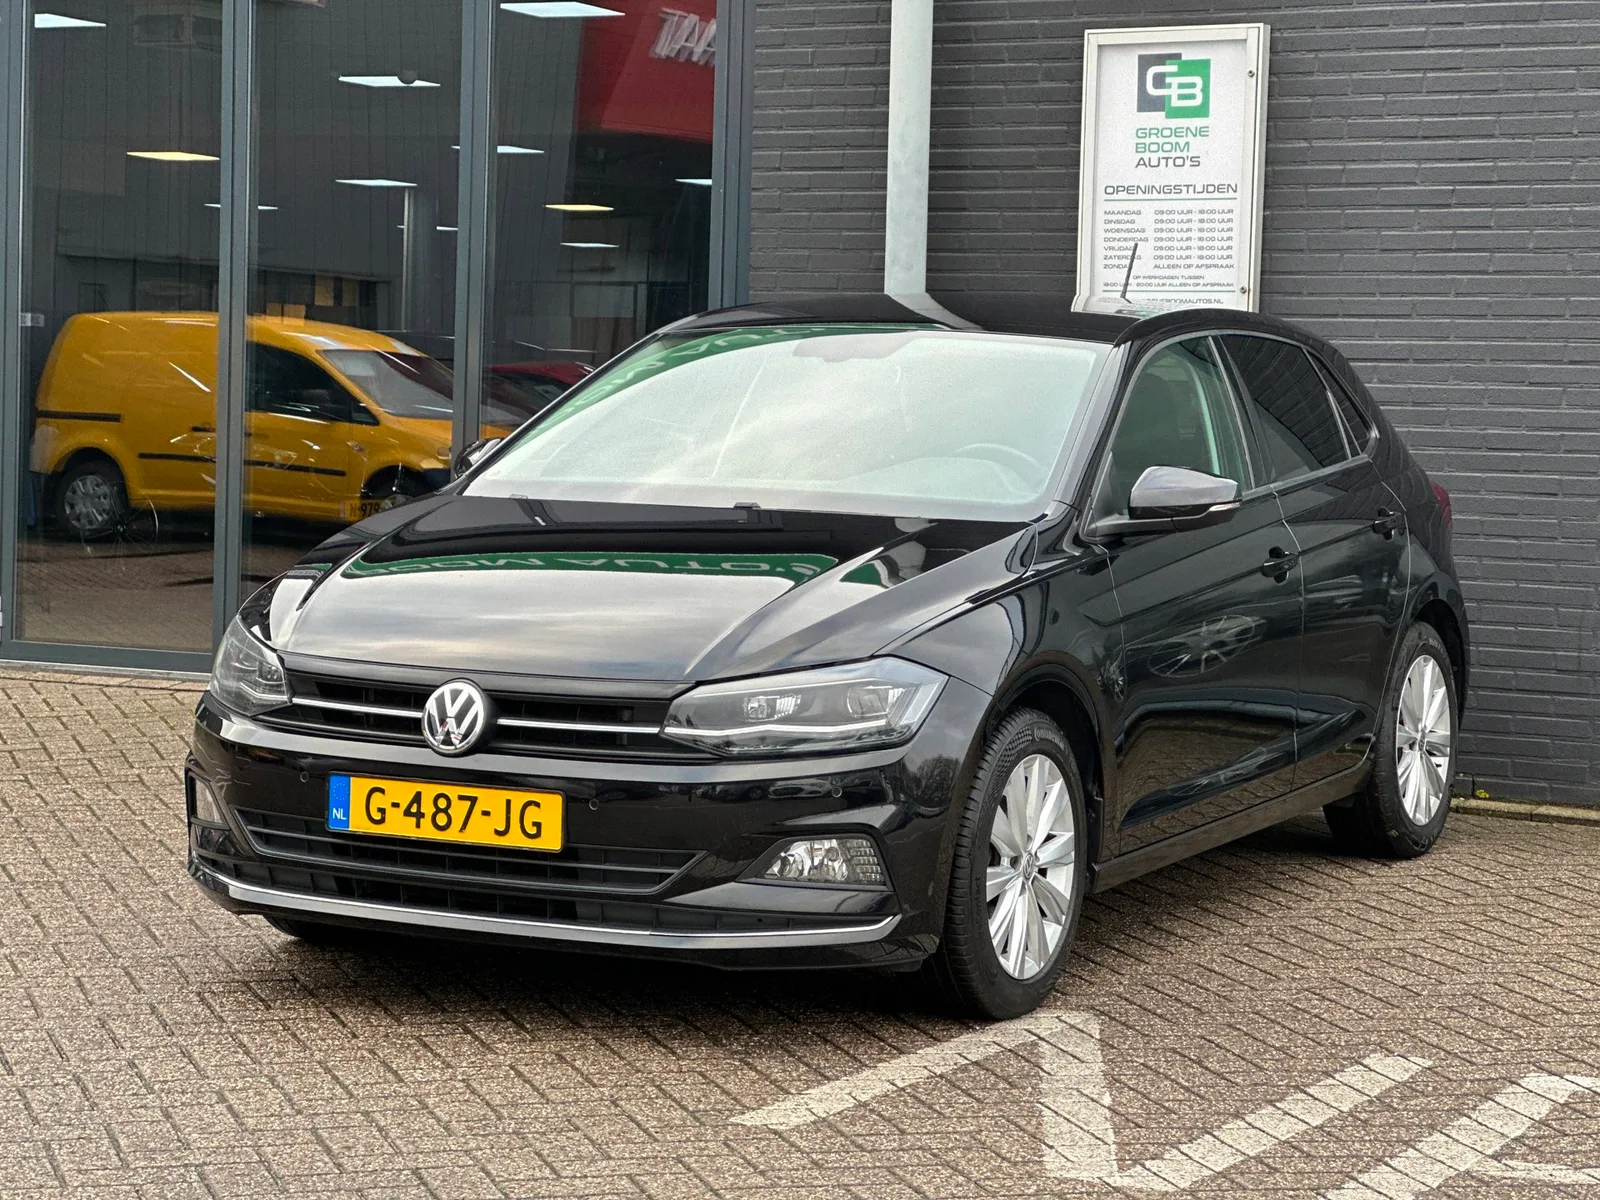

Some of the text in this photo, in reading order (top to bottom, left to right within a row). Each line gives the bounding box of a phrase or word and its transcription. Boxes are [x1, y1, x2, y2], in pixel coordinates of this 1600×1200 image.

[1135, 126, 1210, 139] GROENE
[1135, 141, 1190, 154] BOOM
[1135, 156, 1201, 168] AUTO'S
[1104, 183, 1238, 195] OPENINGSTIJDEN
[333, 786, 543, 839] NL G-487-JG
